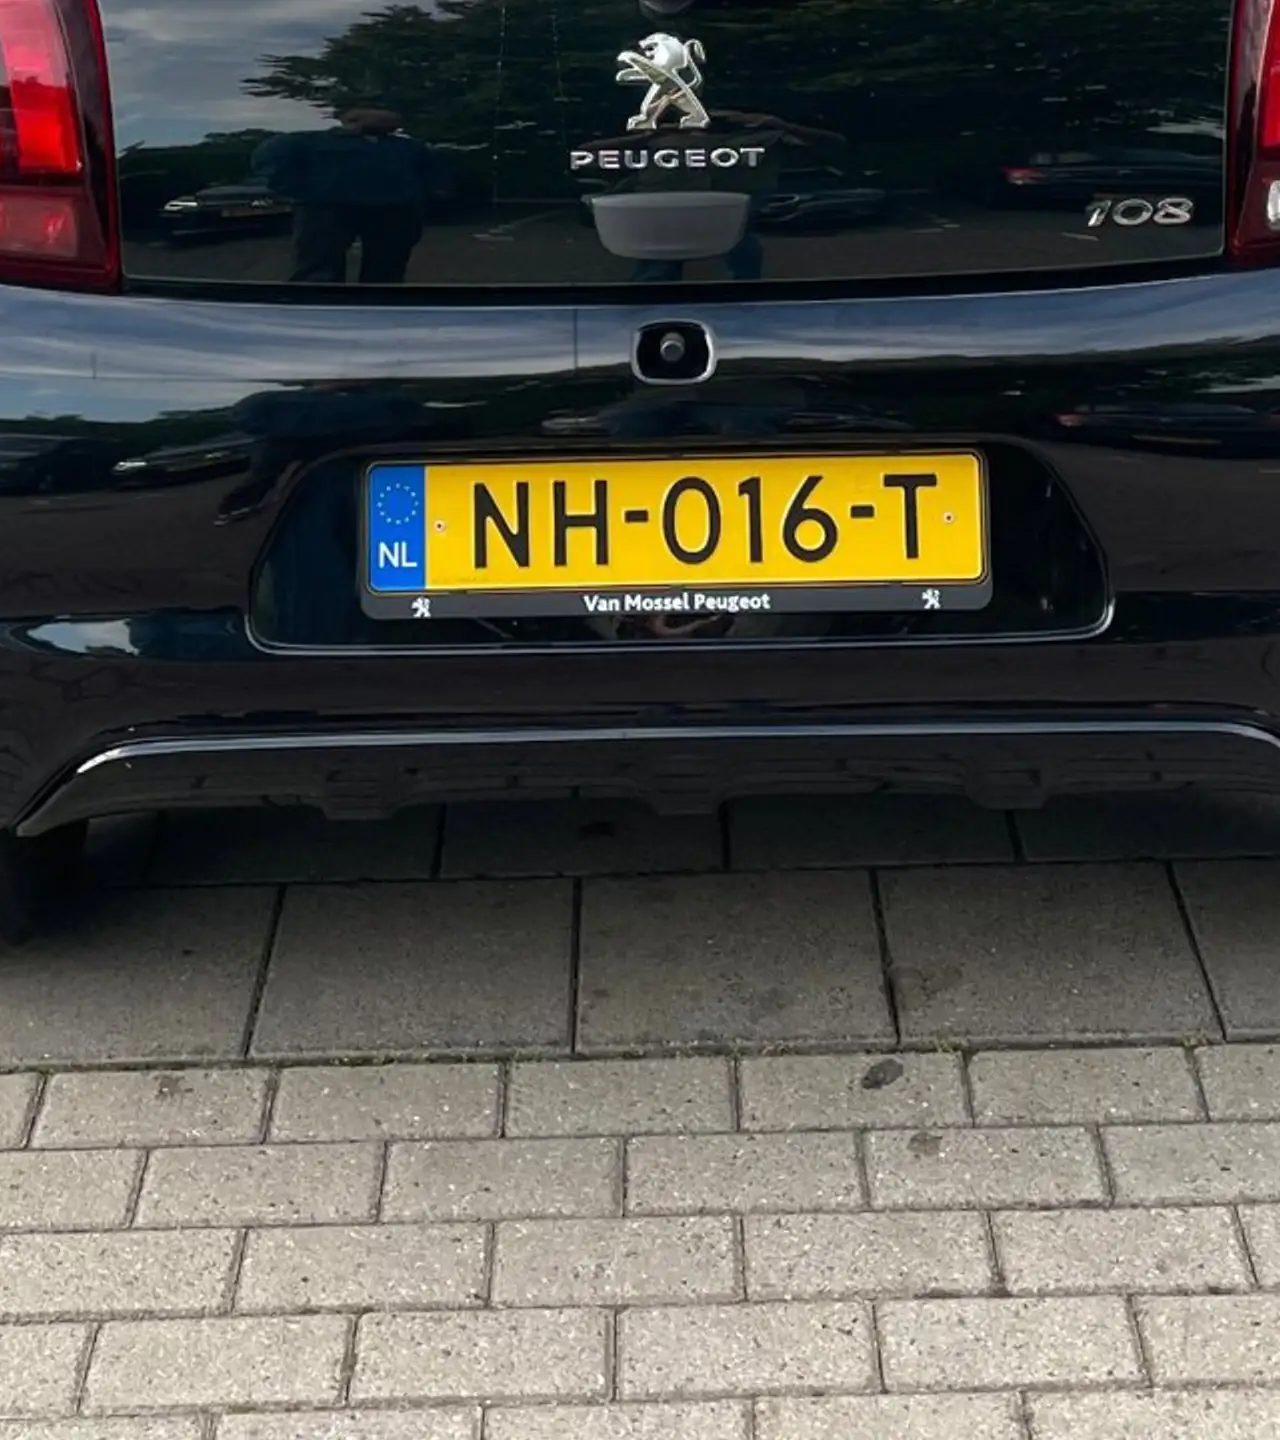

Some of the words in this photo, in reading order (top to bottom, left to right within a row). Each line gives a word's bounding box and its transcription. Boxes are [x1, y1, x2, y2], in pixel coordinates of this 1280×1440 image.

[570, 147, 765, 170] PEUGEOT
[1086, 197, 1193, 228] 108
[473, 473, 937, 569] NH-016-T
[379, 542, 417, 569] NL
[584, 593, 621, 612] Van
[624, 592, 690, 612] Mossel
[693, 592, 771, 617] Peugeot
